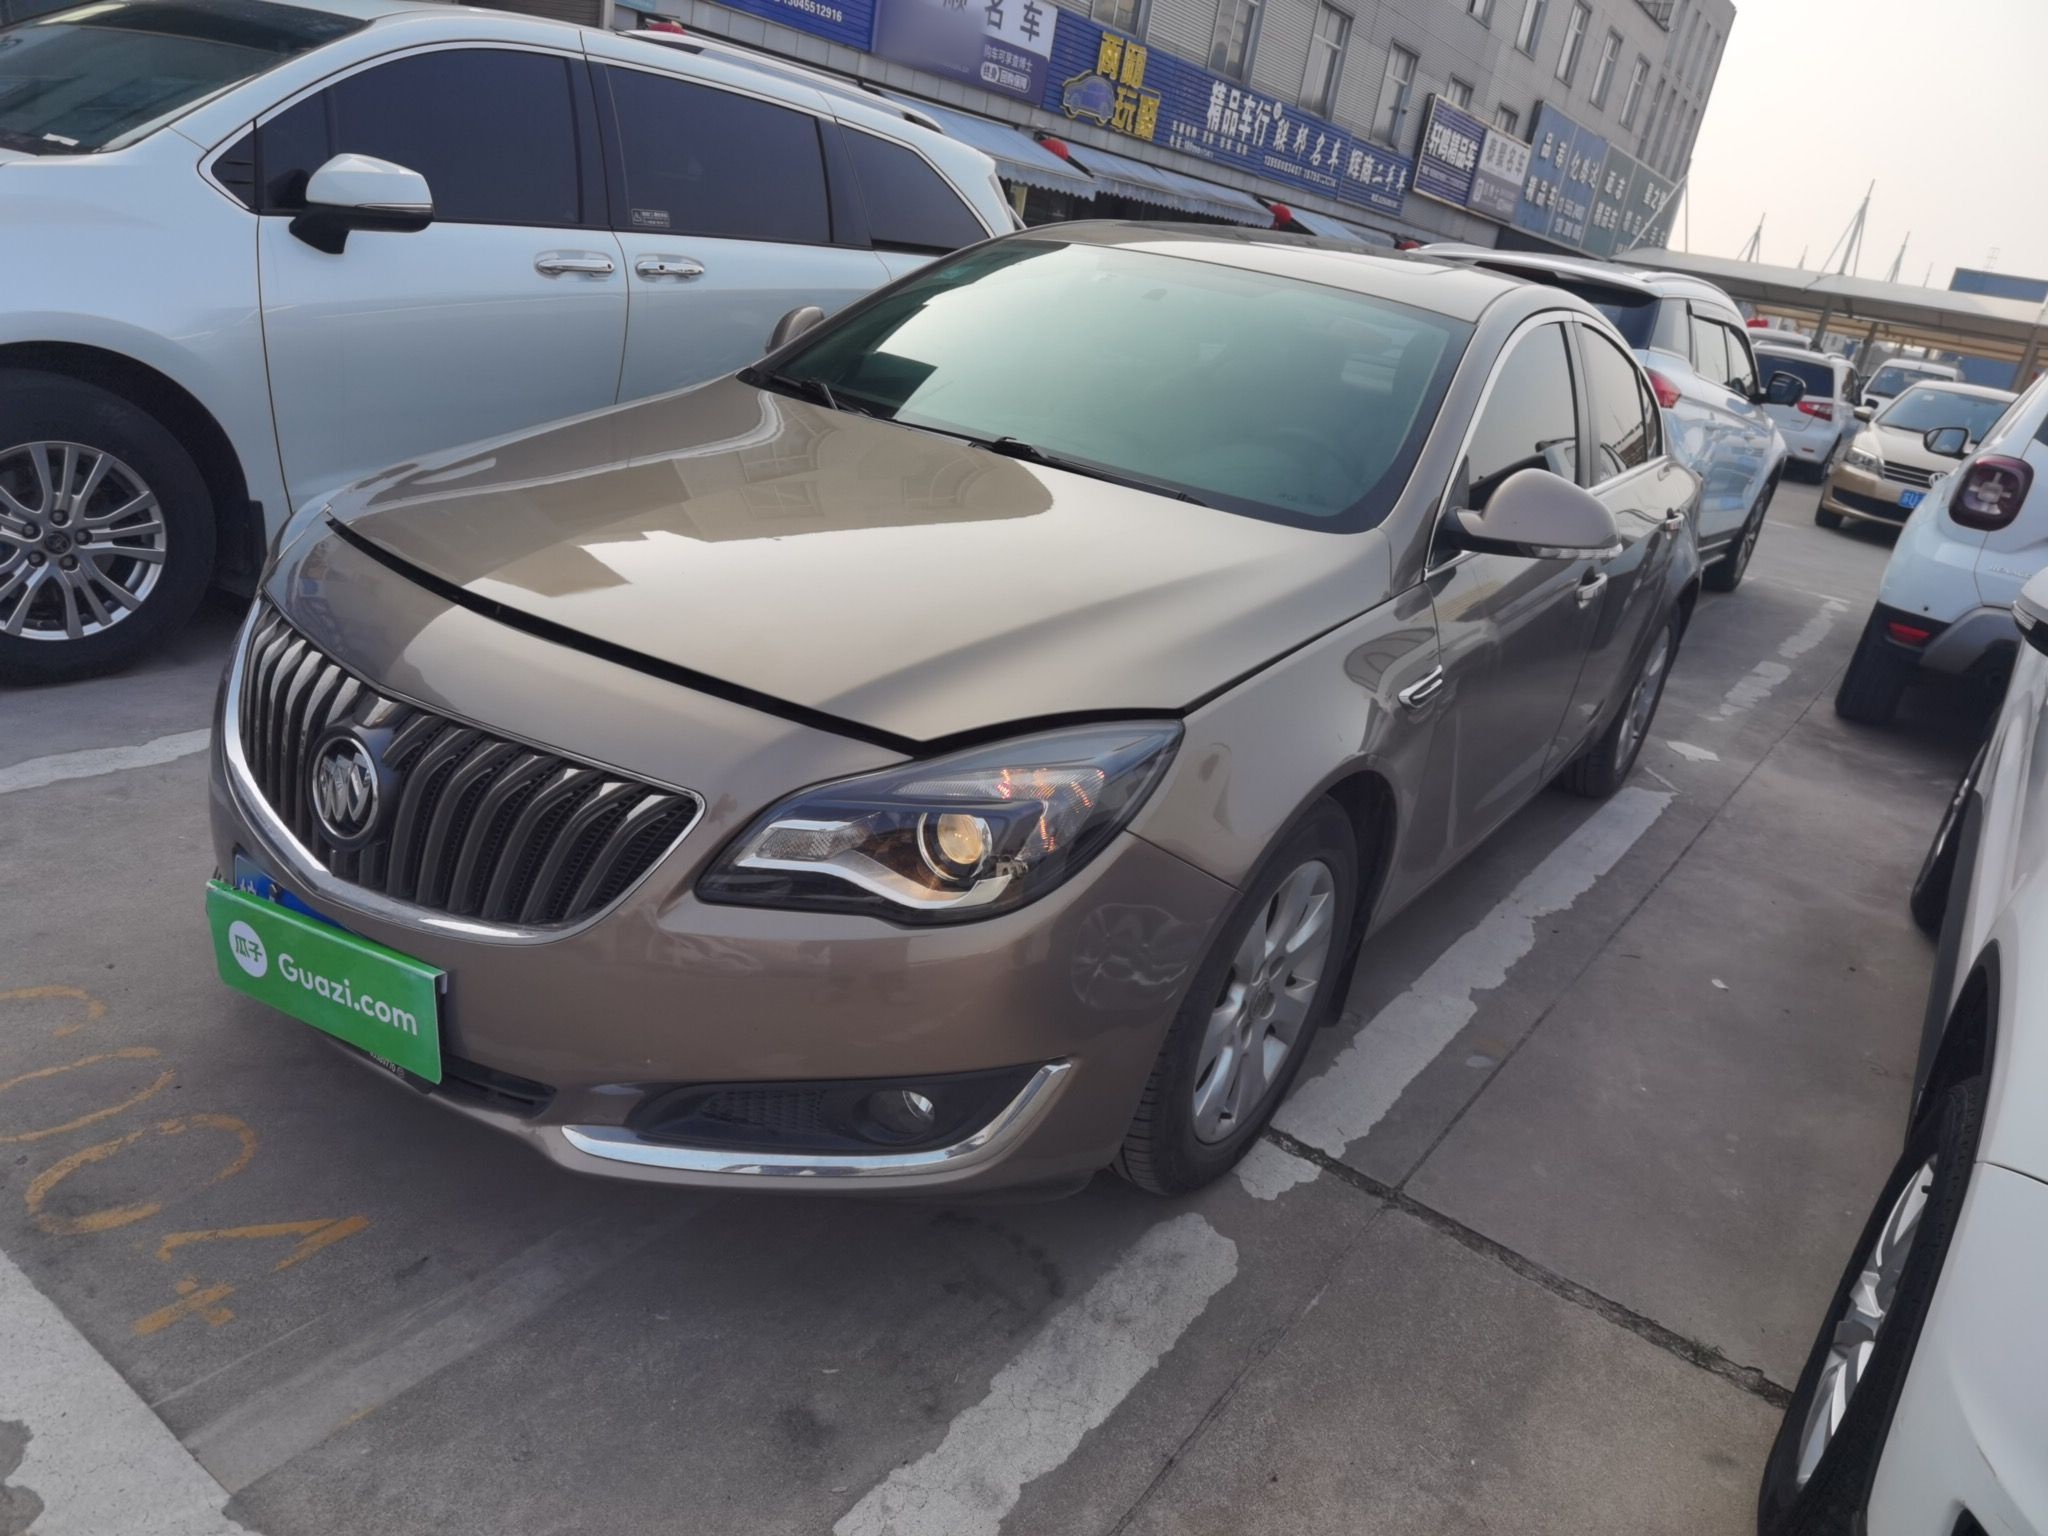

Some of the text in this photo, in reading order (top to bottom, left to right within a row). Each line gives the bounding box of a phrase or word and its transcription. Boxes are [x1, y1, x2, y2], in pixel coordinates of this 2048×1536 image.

[1207, 80, 1271, 146] 精品车行
[234, 934, 418, 1036] 瓜子 Guazi.com
